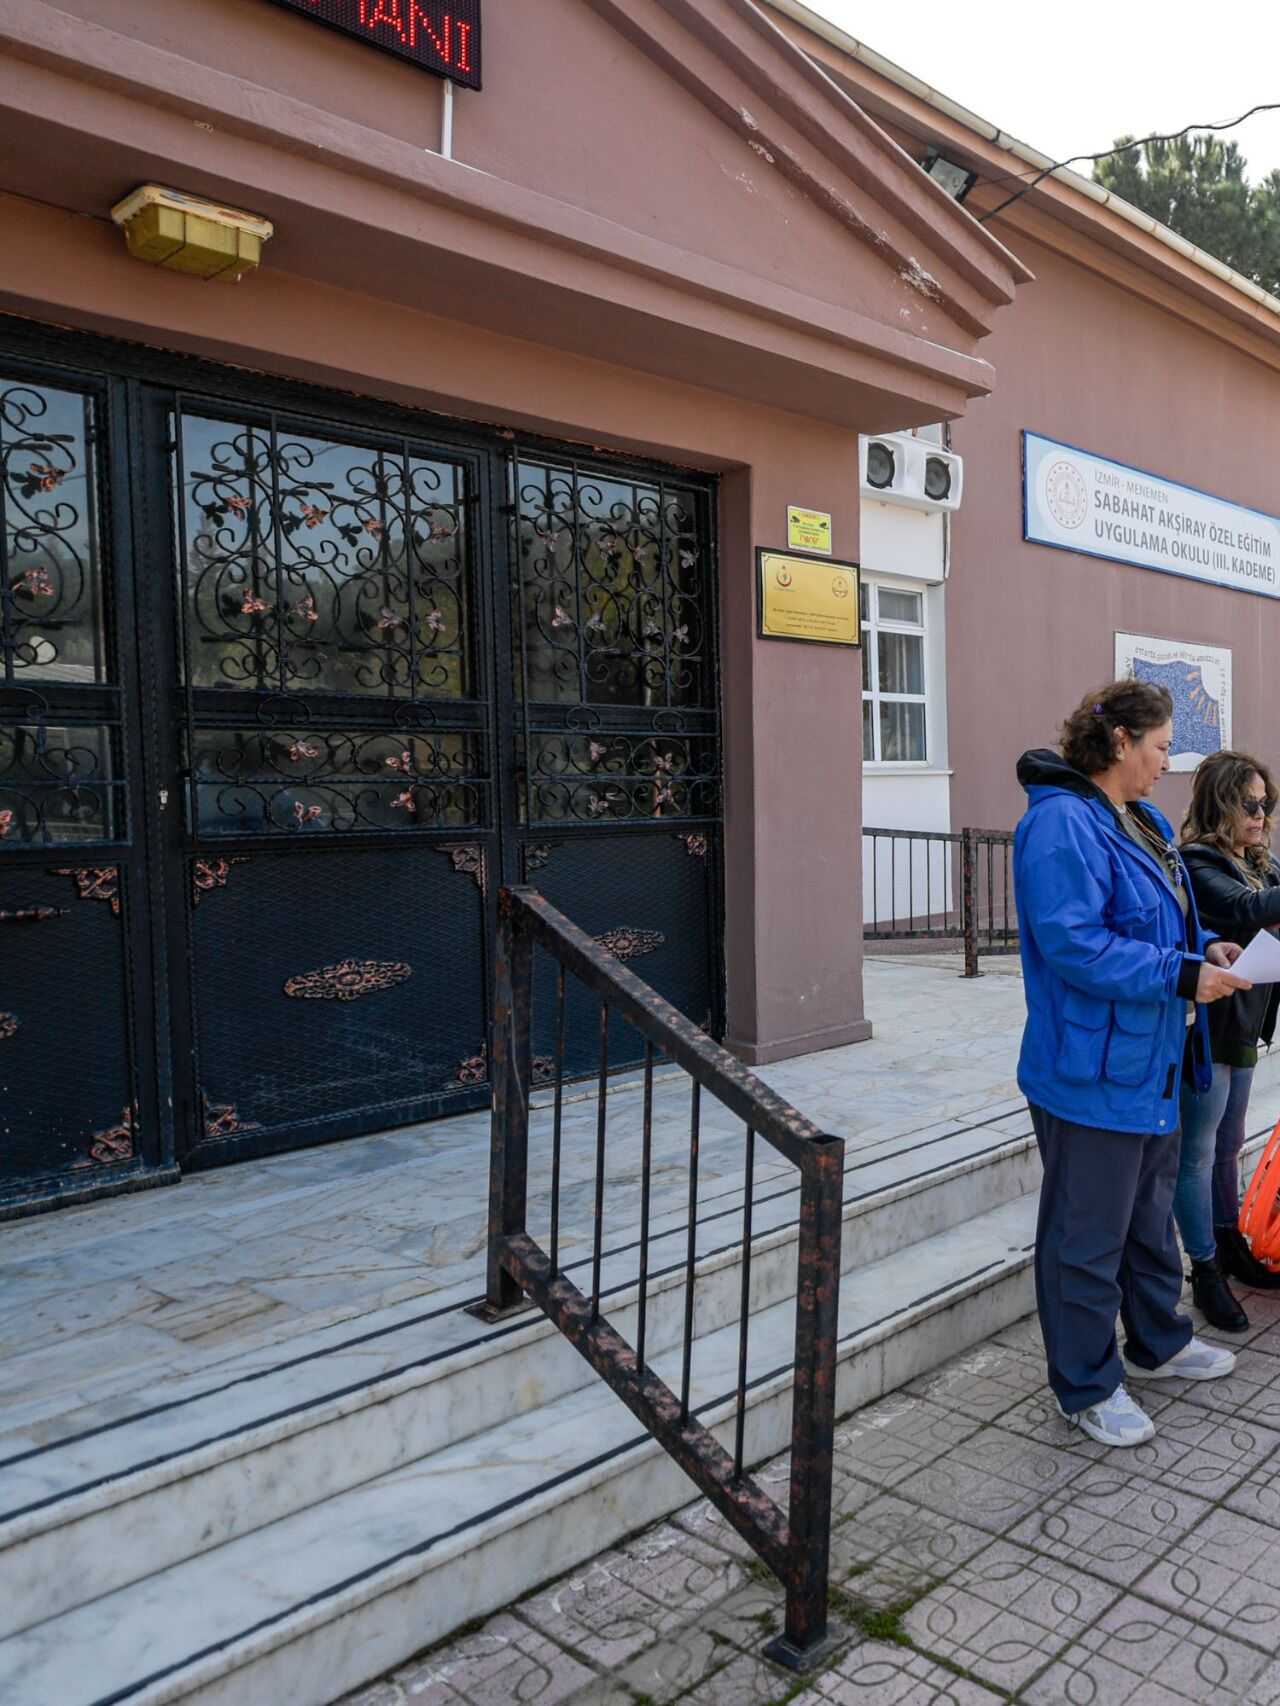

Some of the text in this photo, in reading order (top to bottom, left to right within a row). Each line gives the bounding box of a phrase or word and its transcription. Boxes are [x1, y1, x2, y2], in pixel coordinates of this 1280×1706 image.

[1094, 469, 1120, 489] İZMİR
[1126, 481, 1168, 504] MENEMEN
[1094, 489, 1155, 523] SABAHAT
[1158, 509, 1207, 539] AKŞİRAY
[1209, 521, 1235, 548] ÖZEL
[1237, 532, 1271, 558] EĞİTİM
[1094, 518, 1276, 584] UYGULAMA OKULU (III. KADEME)
